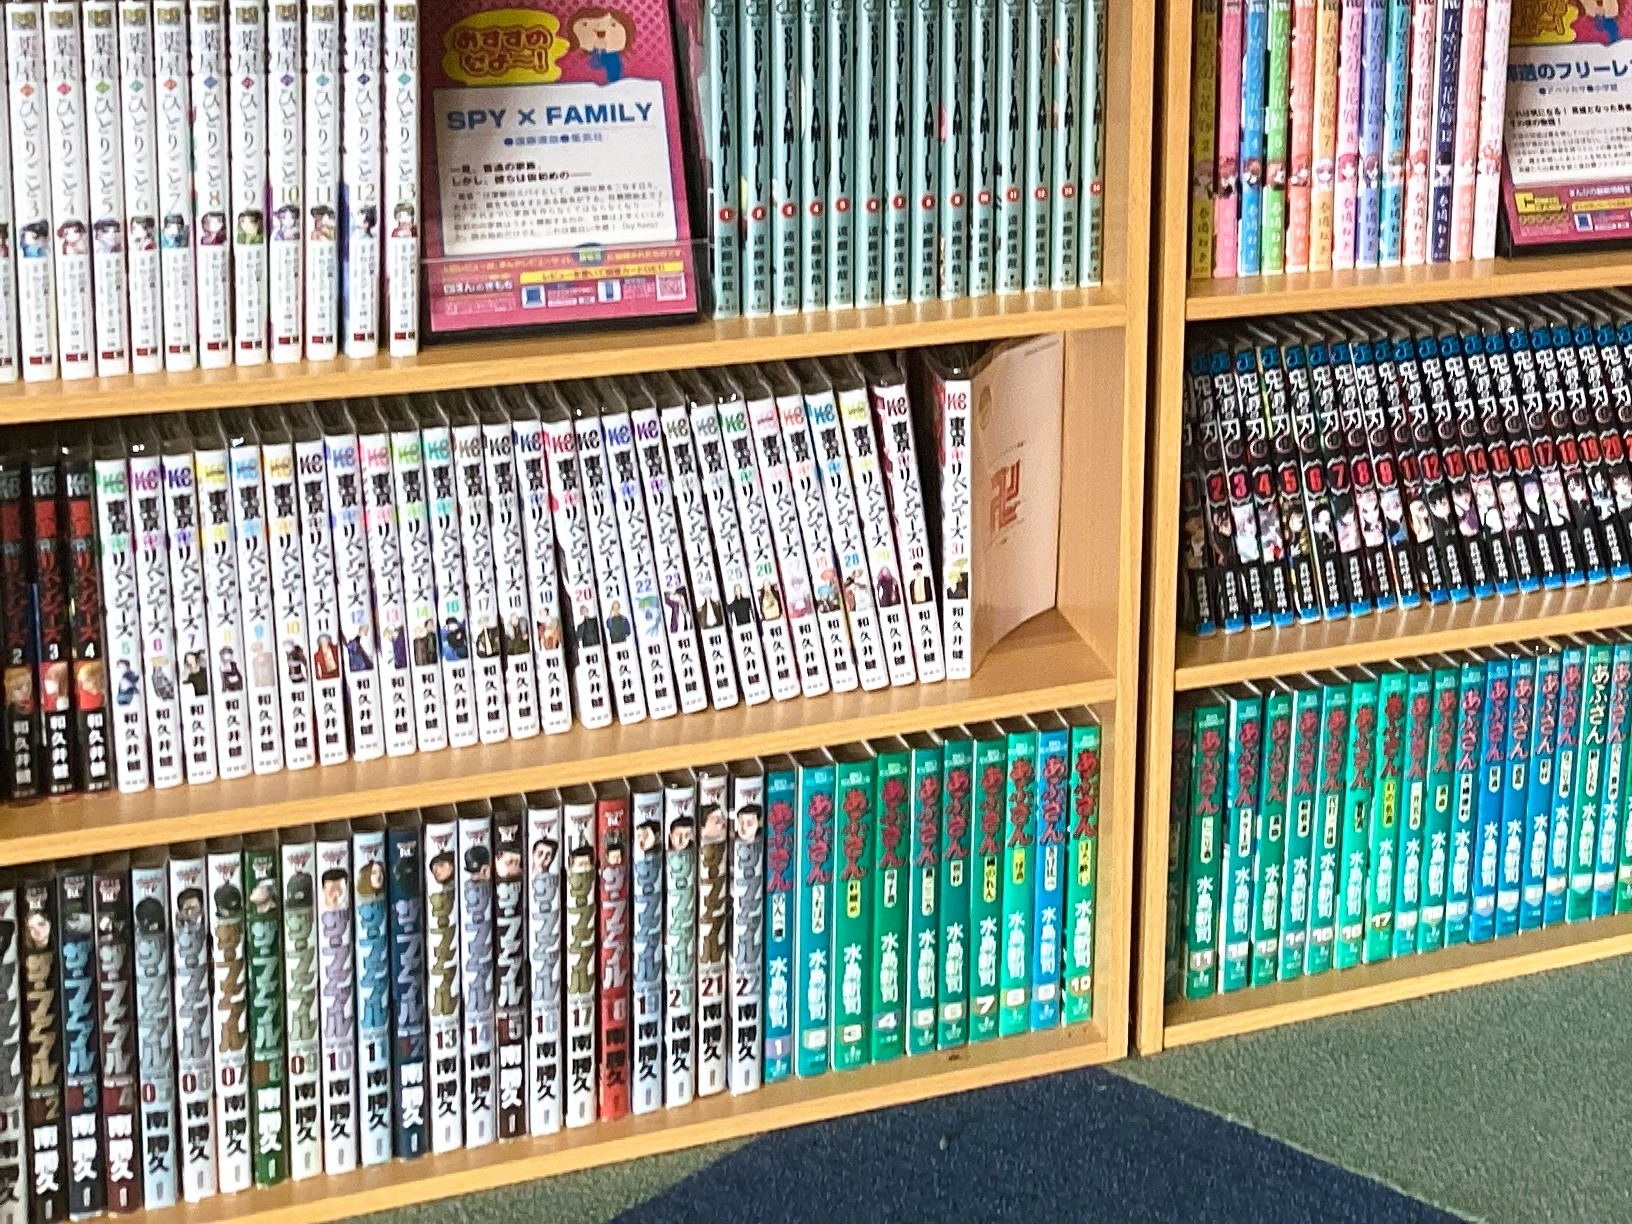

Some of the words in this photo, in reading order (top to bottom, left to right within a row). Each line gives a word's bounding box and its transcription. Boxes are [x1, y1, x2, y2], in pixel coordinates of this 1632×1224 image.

[447, 108, 506, 131] SPY
[546, 102, 652, 126] FAMILY
[1380, 462, 1391, 482] 9
[1425, 457, 1439, 477] 12
[1258, 473, 1271, 495] 4
[1284, 470, 1295, 492] 5
[951, 542, 967, 556] 31
[844, 553, 860, 568] 28
[664, 573, 682, 588] 23
[575, 587, 592, 602] 20
[605, 585, 620, 599] 21
[477, 598, 490, 612] 17
[571, 1003, 592, 1027] 17
[435, 1027, 458, 1050] 13
